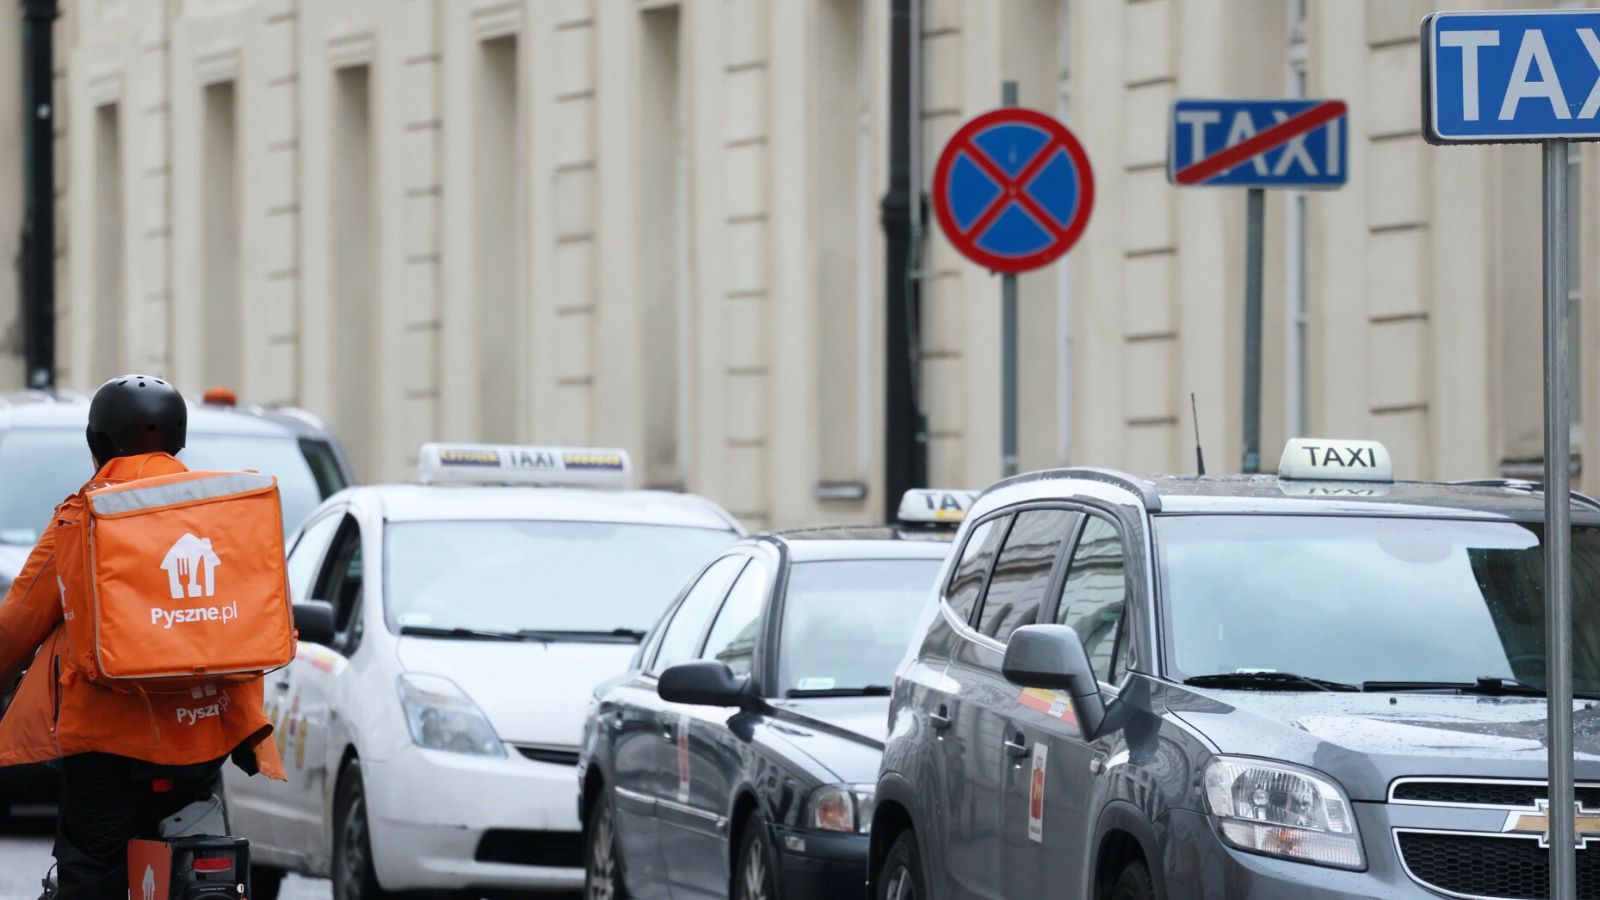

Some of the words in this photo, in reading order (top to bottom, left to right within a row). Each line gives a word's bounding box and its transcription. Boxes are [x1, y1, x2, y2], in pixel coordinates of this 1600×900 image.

[1177, 109, 1340, 177] TAXI
[508, 450, 555, 468] TAXI
[1302, 446, 1376, 468] TAXI
[151, 600, 238, 629] Pyszne.pl
